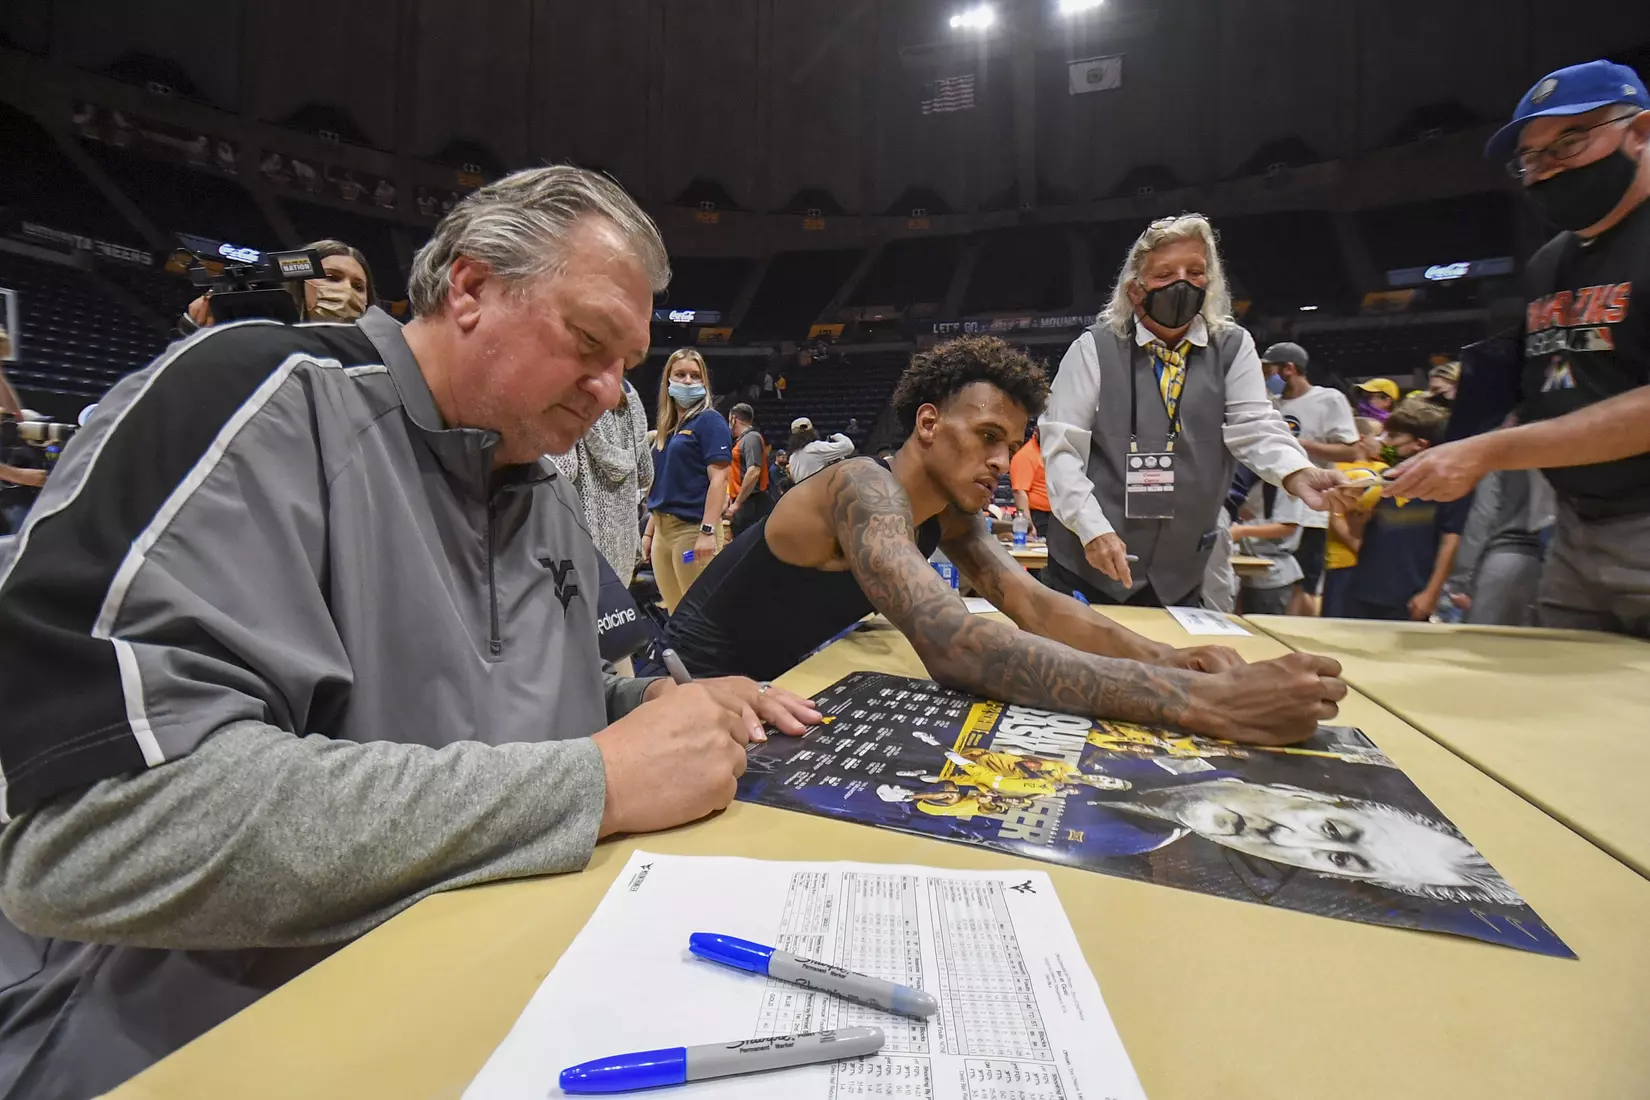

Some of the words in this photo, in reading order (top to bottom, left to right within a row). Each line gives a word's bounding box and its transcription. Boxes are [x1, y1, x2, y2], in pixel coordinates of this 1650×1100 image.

[283, 264, 310, 272] NATION
[598, 607, 636, 633] edicine
[802, 964, 827, 974] Permanent
[830, 970, 847, 979] Marker
[768, 993, 776, 1006] GOLD
[784, 995, 792, 1007] BLUE
[739, 1045, 770, 1053] Permanent
